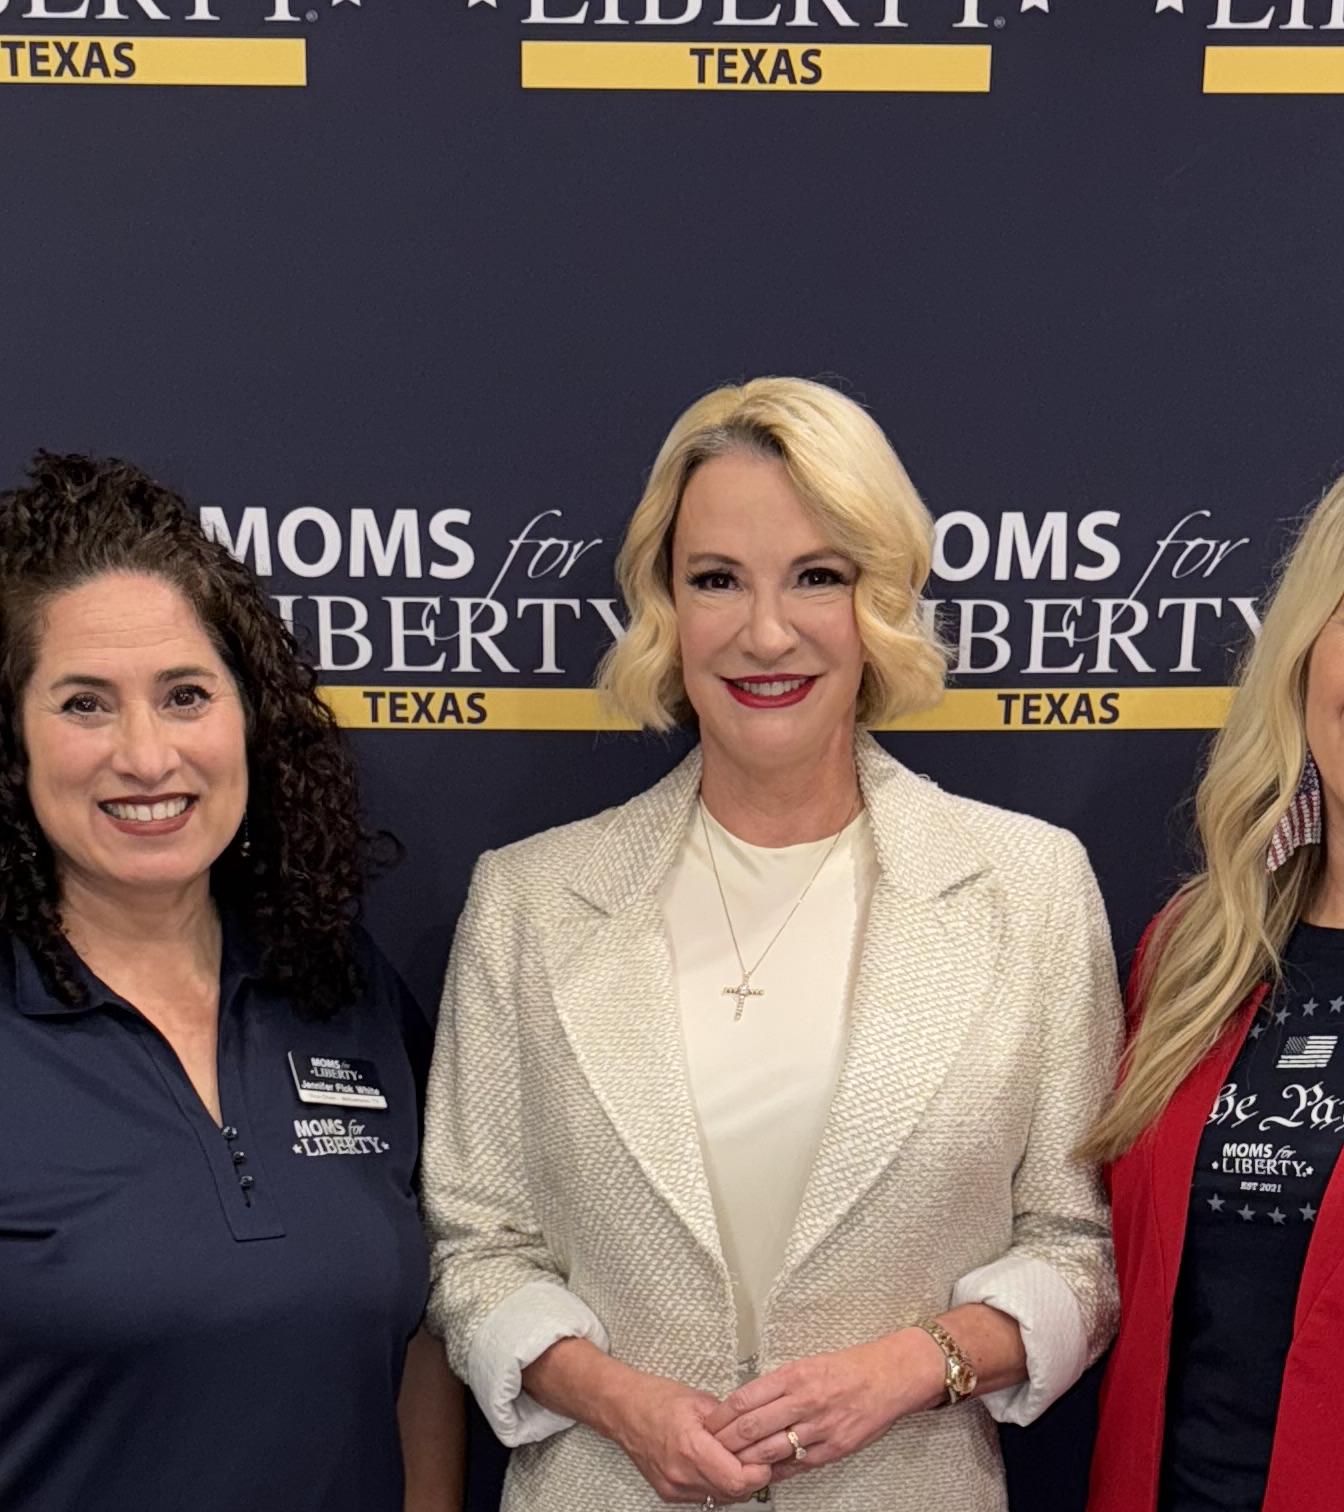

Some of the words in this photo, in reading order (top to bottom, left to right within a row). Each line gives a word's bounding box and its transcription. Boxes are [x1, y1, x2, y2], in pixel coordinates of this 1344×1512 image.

[0, 40, 136, 79] TEXAS
[689, 48, 823, 85] TEXAS
[200, 506, 475, 579] MOMS
[931, 510, 1121, 581] OMS
[363, 692, 487, 725] TEXAS
[997, 693, 1119, 725] TEXAS
[311, 1057, 340, 1069] MOMS
[314, 1067, 357, 1080] LIBERTY
[294, 1118, 345, 1138] MOMS
[347, 1119, 365, 1139] for
[300, 1136, 384, 1156] LIBERTY
[1222, 1143, 1273, 1158] MOMS
[1273, 1145, 1296, 1161] for
[1222, 1158, 1306, 1177] LIBERTY
[1260, 1182, 1282, 1193] 2021
